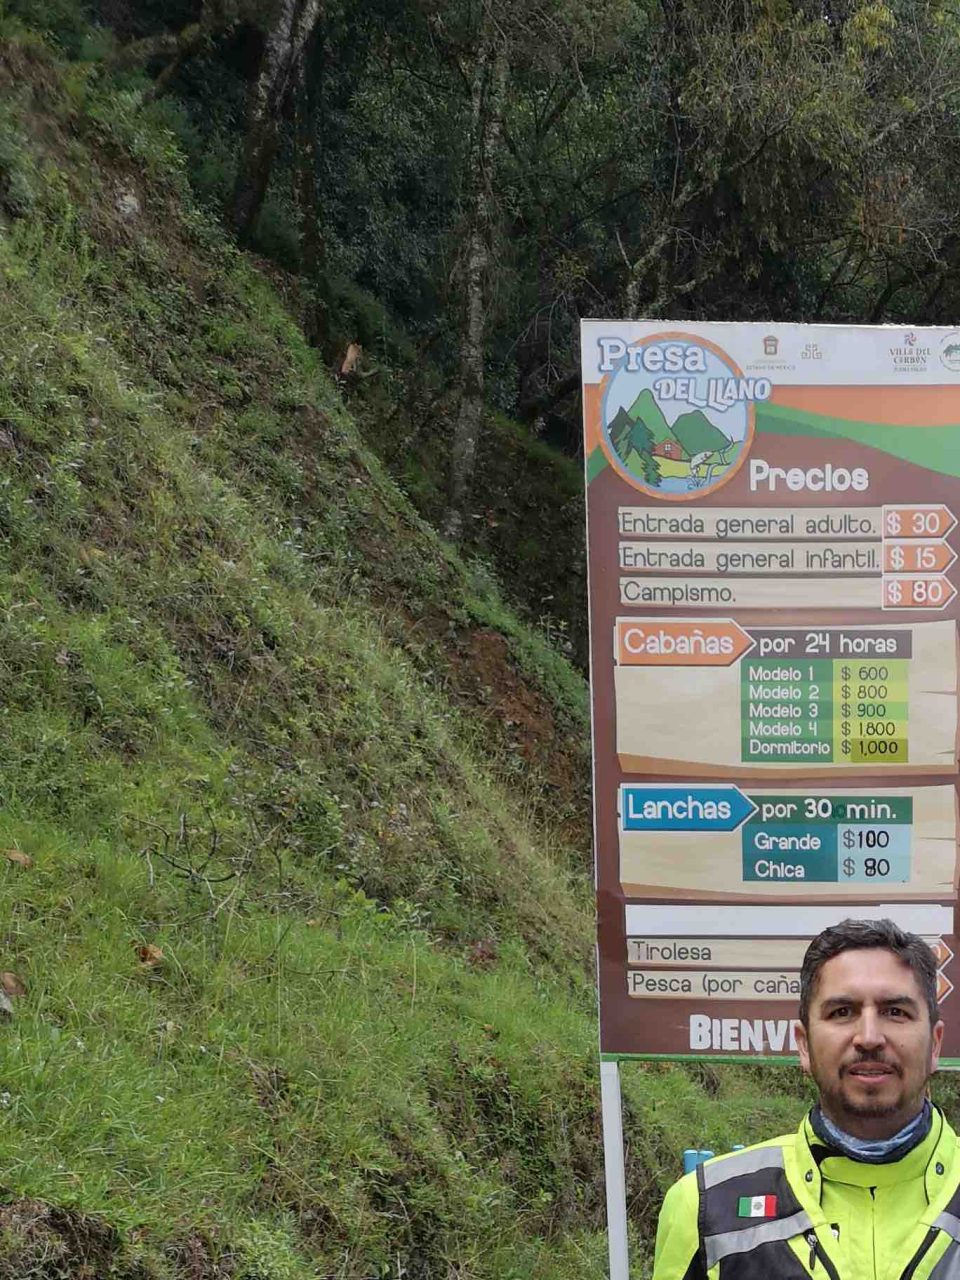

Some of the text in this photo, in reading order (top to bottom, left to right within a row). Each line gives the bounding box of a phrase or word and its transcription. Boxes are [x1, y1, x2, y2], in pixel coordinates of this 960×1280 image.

[598, 337, 706, 374] Presa
[653, 378, 771, 411] DEL LLANO
[750, 459, 869, 491] Precios
[622, 513, 876, 538] Entrada general adulto.
[886, 509, 940, 534] $ 30
[622, 548, 880, 573] Entrada general infantil.
[890, 544, 936, 570] $ 15
[624, 581, 736, 607] Campismo.
[887, 580, 942, 604] $ 80
[623, 628, 734, 655] Cabañas
[760, 632, 897, 659] por 24 horas
[749, 666, 815, 681] Modelo 1
[841, 665, 888, 682] $ 600
[749, 685, 819, 700] Modelo 2
[841, 684, 888, 701] $ 800
[749, 704, 818, 718] Modelo 3
[841, 703, 886, 719] $ 900
[749, 722, 818, 736] Modelo 4
[841, 721, 895, 738] $ 1,800
[749, 741, 831, 755] Dormitorio
[841, 740, 898, 757] $ 1,000
[628, 795, 731, 820] Lanchas
[762, 799, 897, 821] por 30 min.
[754, 832, 821, 851] Grande
[755, 859, 805, 878] Chica
[843, 857, 856, 877] $
[632, 941, 712, 960] Tirolesa
[632, 973, 692, 993] Pesca
[702, 974, 742, 997] (por
